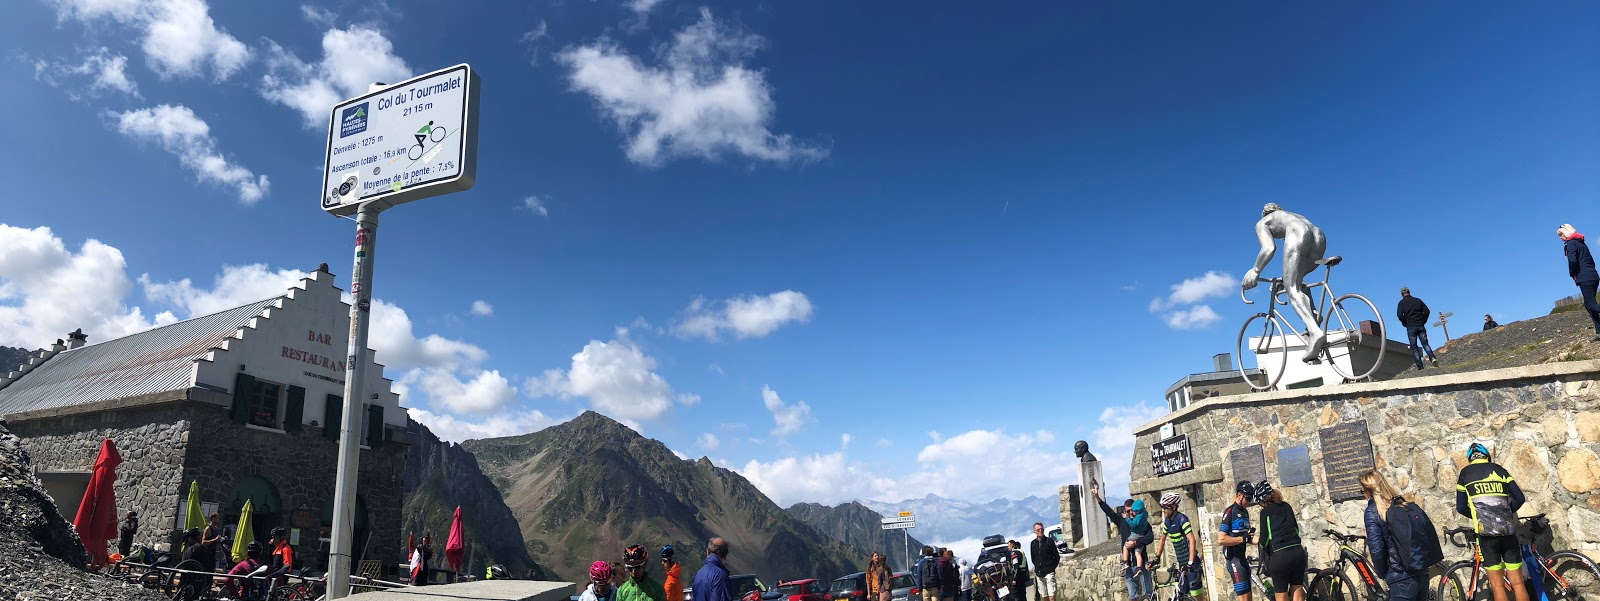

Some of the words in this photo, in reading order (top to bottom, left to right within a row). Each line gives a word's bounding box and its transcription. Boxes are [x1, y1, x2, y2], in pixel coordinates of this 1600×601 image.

[378, 97, 393, 111] Col
[395, 92, 407, 106] du
[409, 76, 461, 101] Tourmalet
[425, 102, 433, 111] m
[361, 136, 376, 147] 1275
[377, 134, 384, 142] m
[360, 155, 378, 167] totale
[396, 147, 407, 156] km
[363, 178, 391, 191] Moyenne
[392, 172, 402, 182] de
[403, 171, 409, 180] la
[410, 166, 430, 179] pente
[308, 330, 332, 345] BAR
[281, 346, 346, 373] RESTAURAN
[1474, 482, 1504, 494] STELVIO
